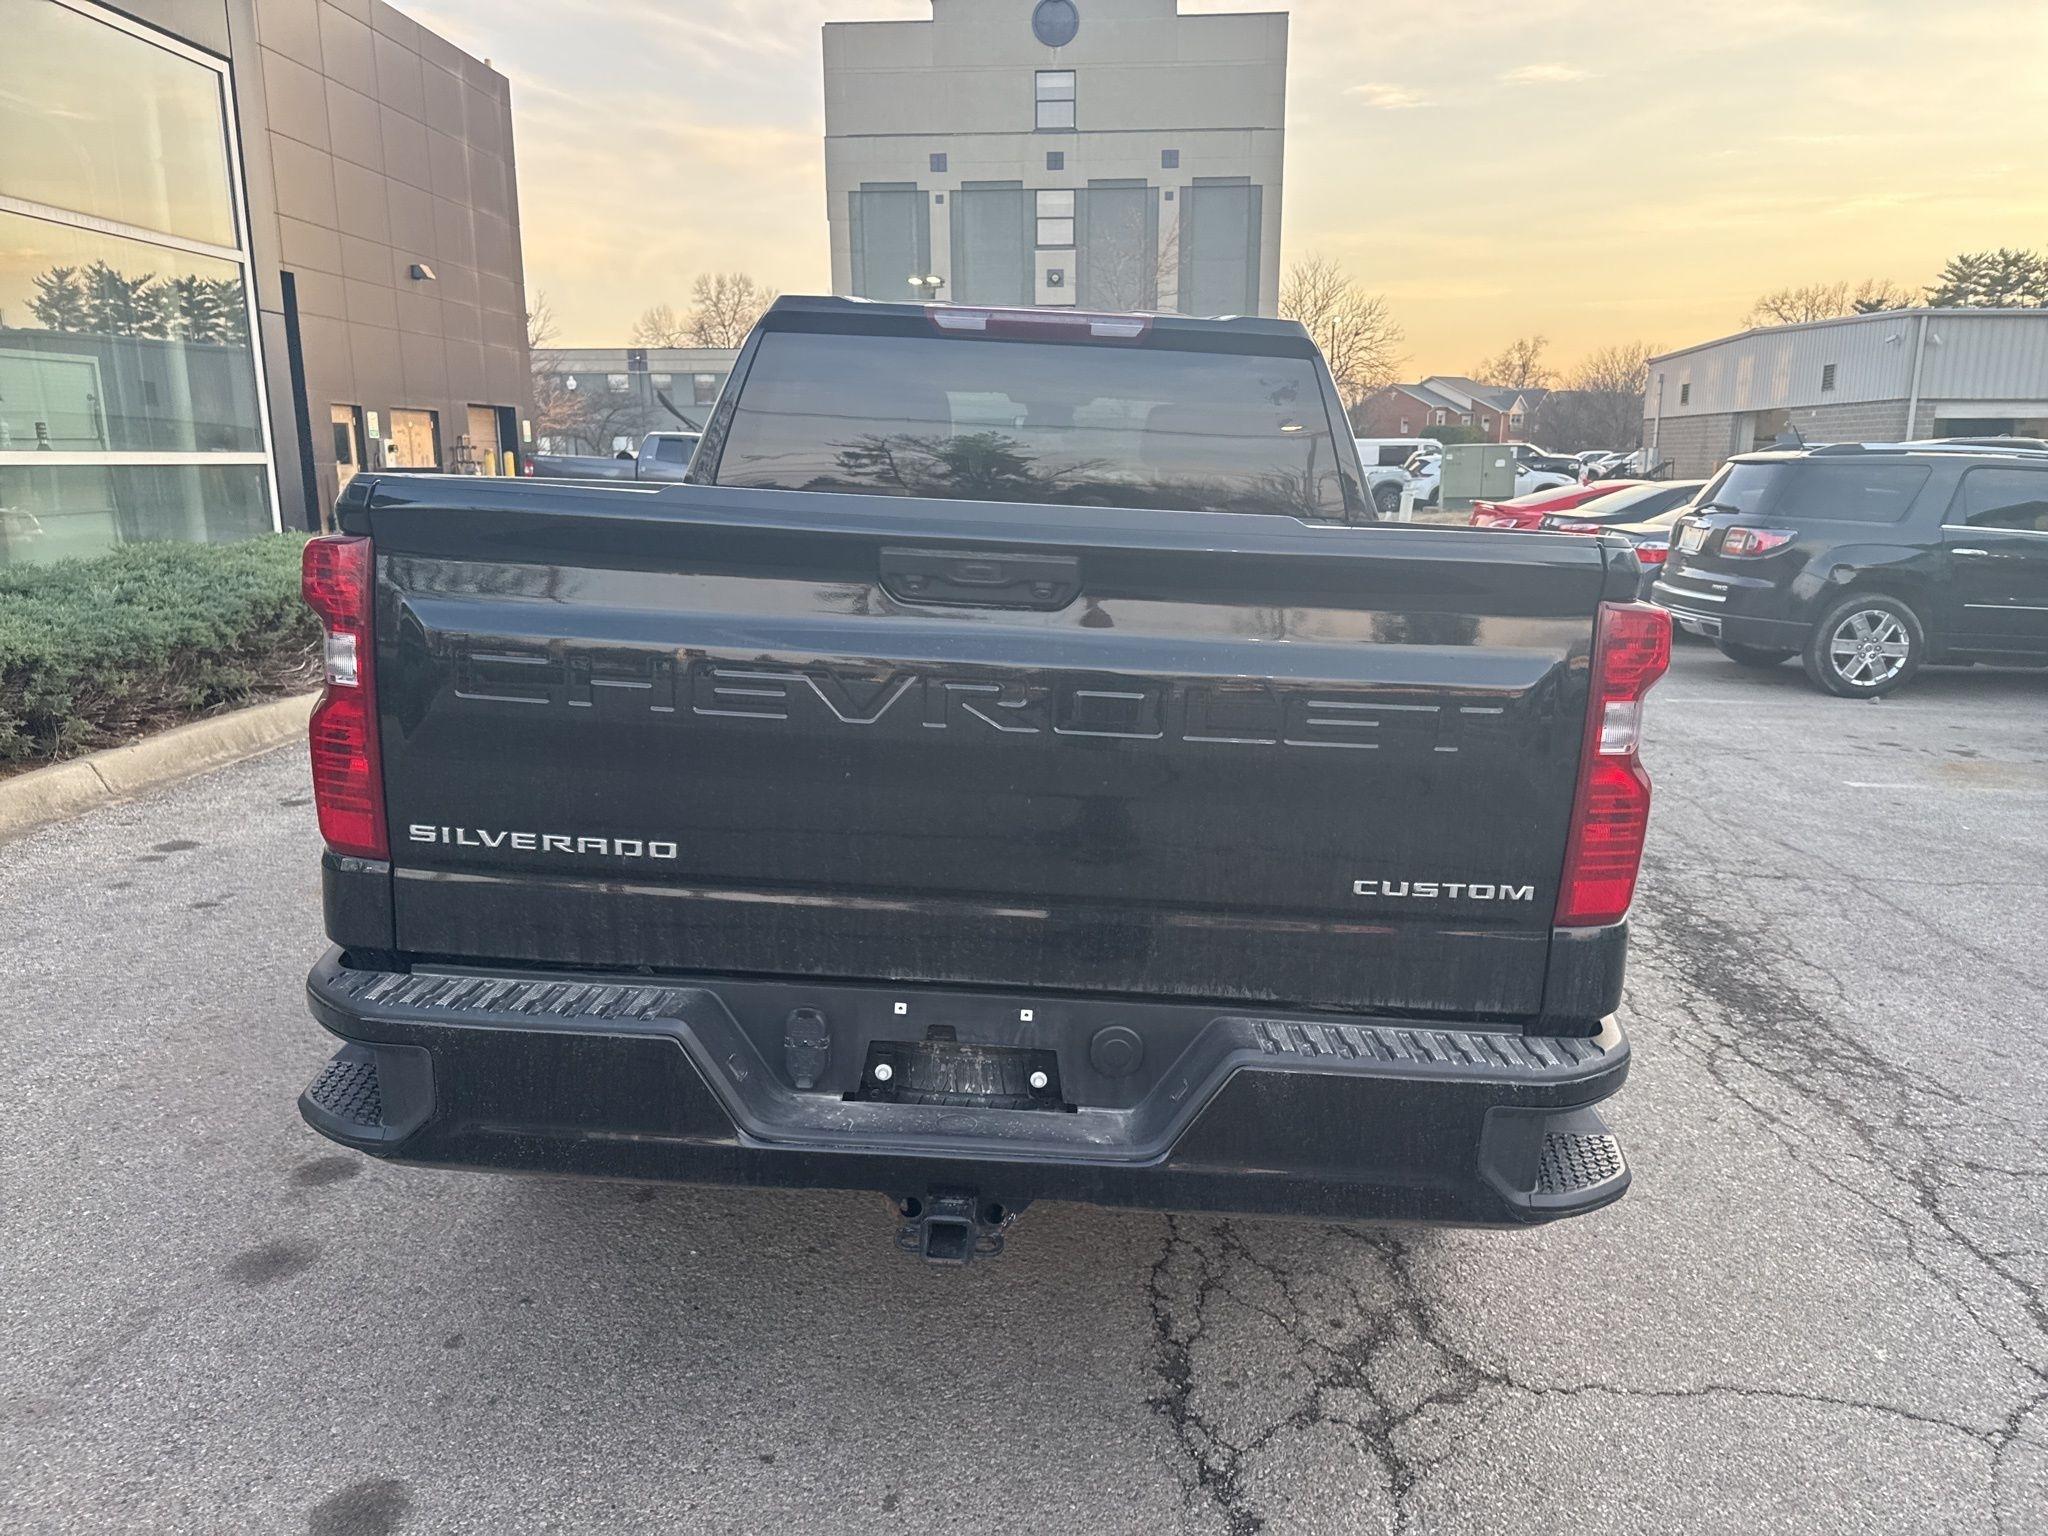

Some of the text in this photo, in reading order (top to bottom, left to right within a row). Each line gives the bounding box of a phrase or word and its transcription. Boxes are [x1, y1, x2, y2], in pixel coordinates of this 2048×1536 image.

[455, 653, 1504, 752] CHEVROLET
[408, 824, 678, 859] SILVERADO
[1352, 880, 1536, 901] CUSTOM
